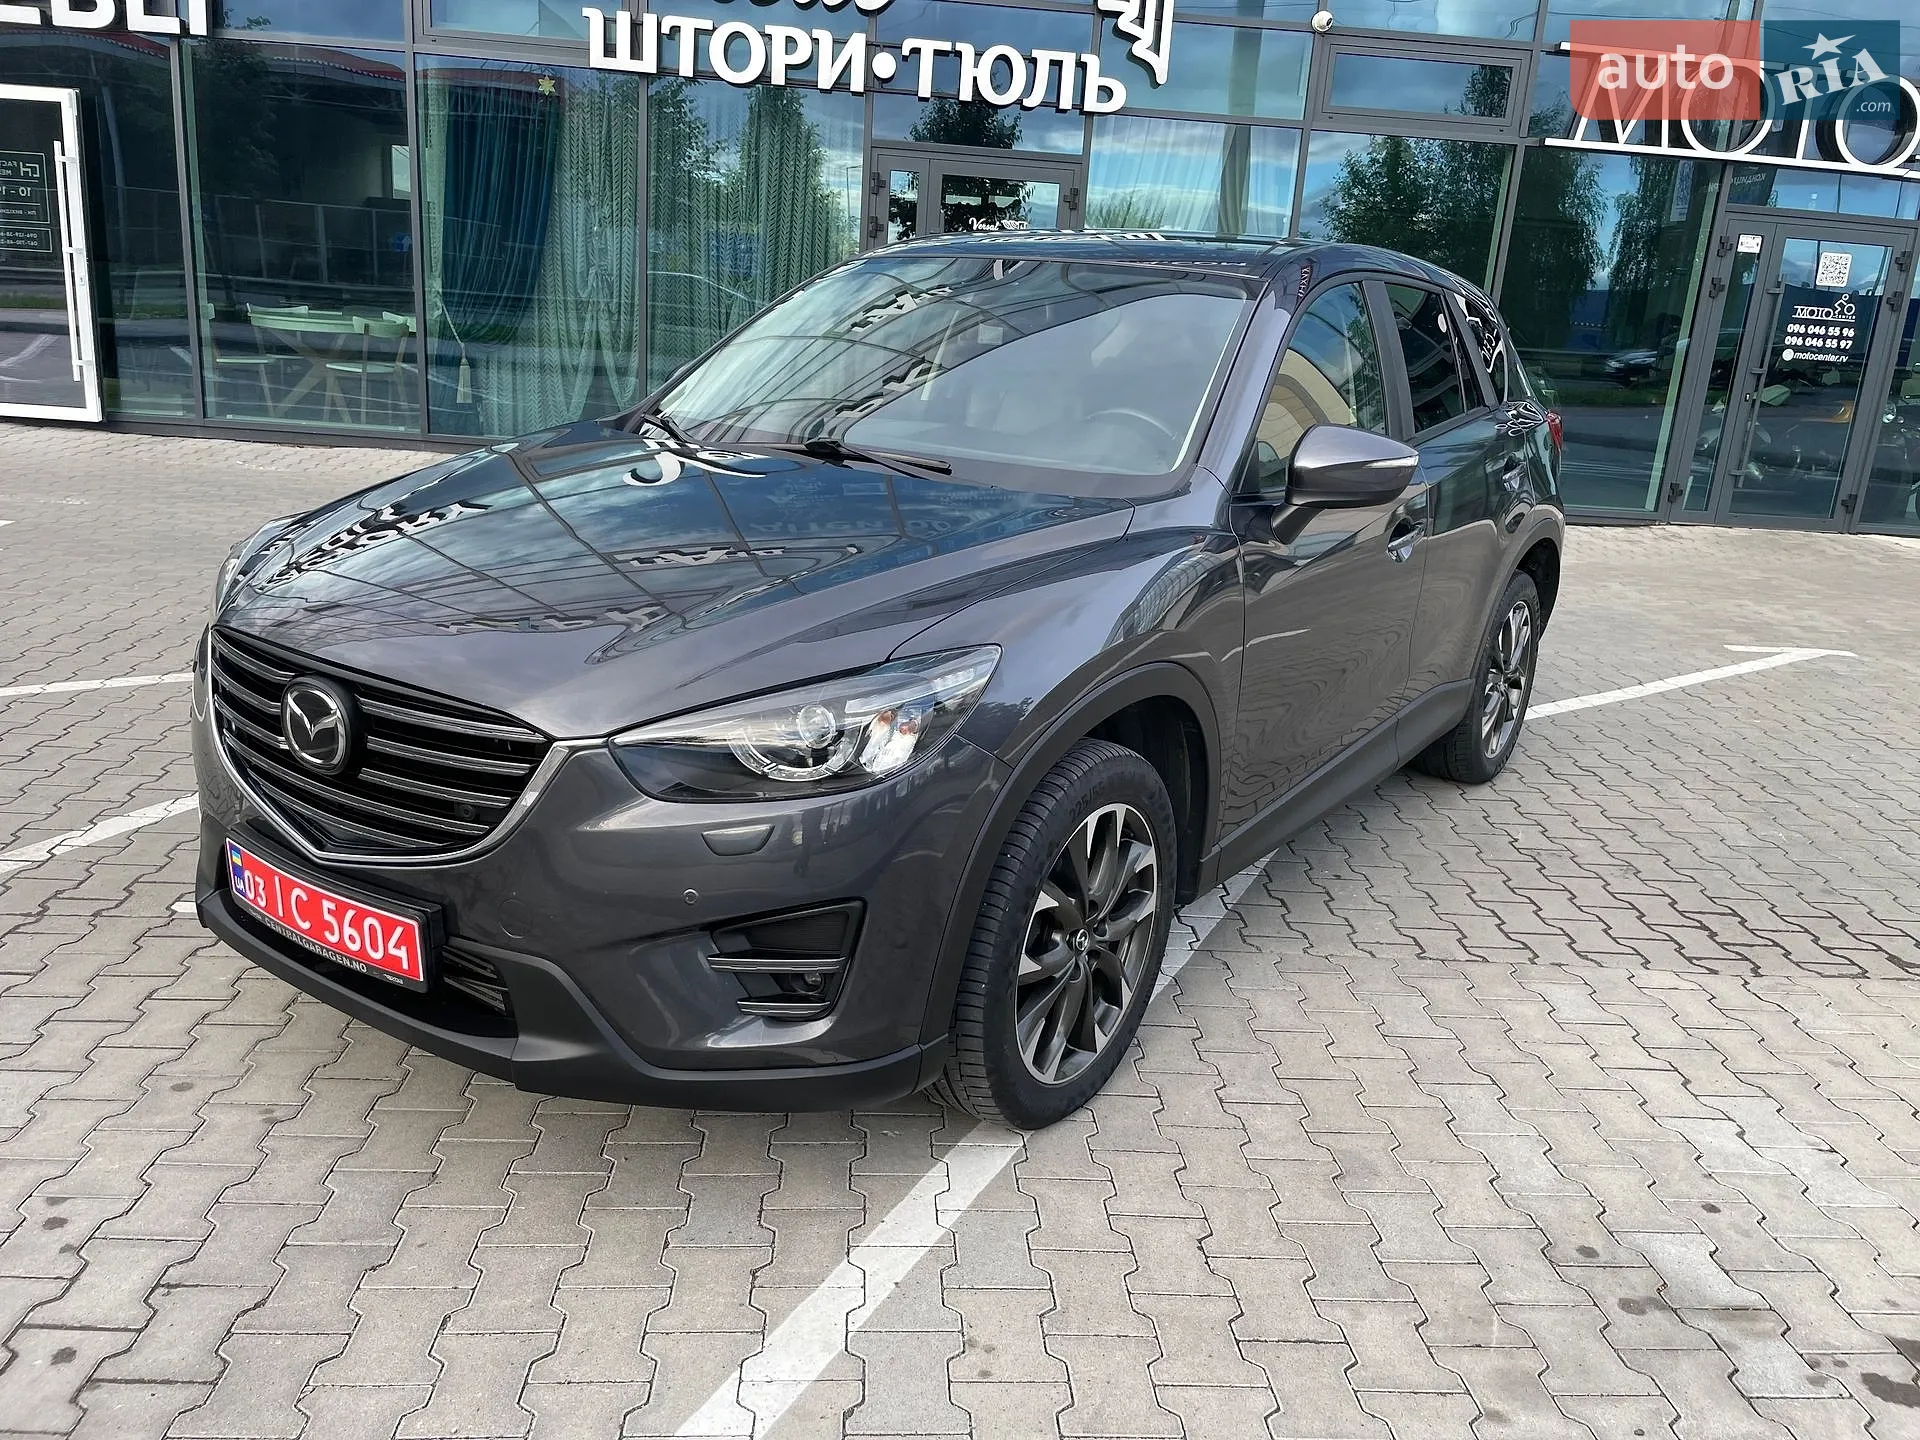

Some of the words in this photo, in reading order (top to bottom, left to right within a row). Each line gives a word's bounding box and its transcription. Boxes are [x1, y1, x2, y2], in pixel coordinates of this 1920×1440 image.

[969, 217, 999, 231] Versal
[1792, 305, 1834, 320] MOTO
[1787, 323, 1806, 334] 096
[1807, 325, 1826, 335] 046
[1827, 326, 1840, 336] 55
[1842, 327, 1855, 338] 96
[1784, 336, 1803, 346] 096
[1804, 337, 1823, 347] 046
[1825, 338, 1838, 348] 55
[1839, 340, 1853, 350] 97
[234, 875, 245, 893] UA
[243, 869, 267, 908] 03
[321, 899, 409, 971] 5604
